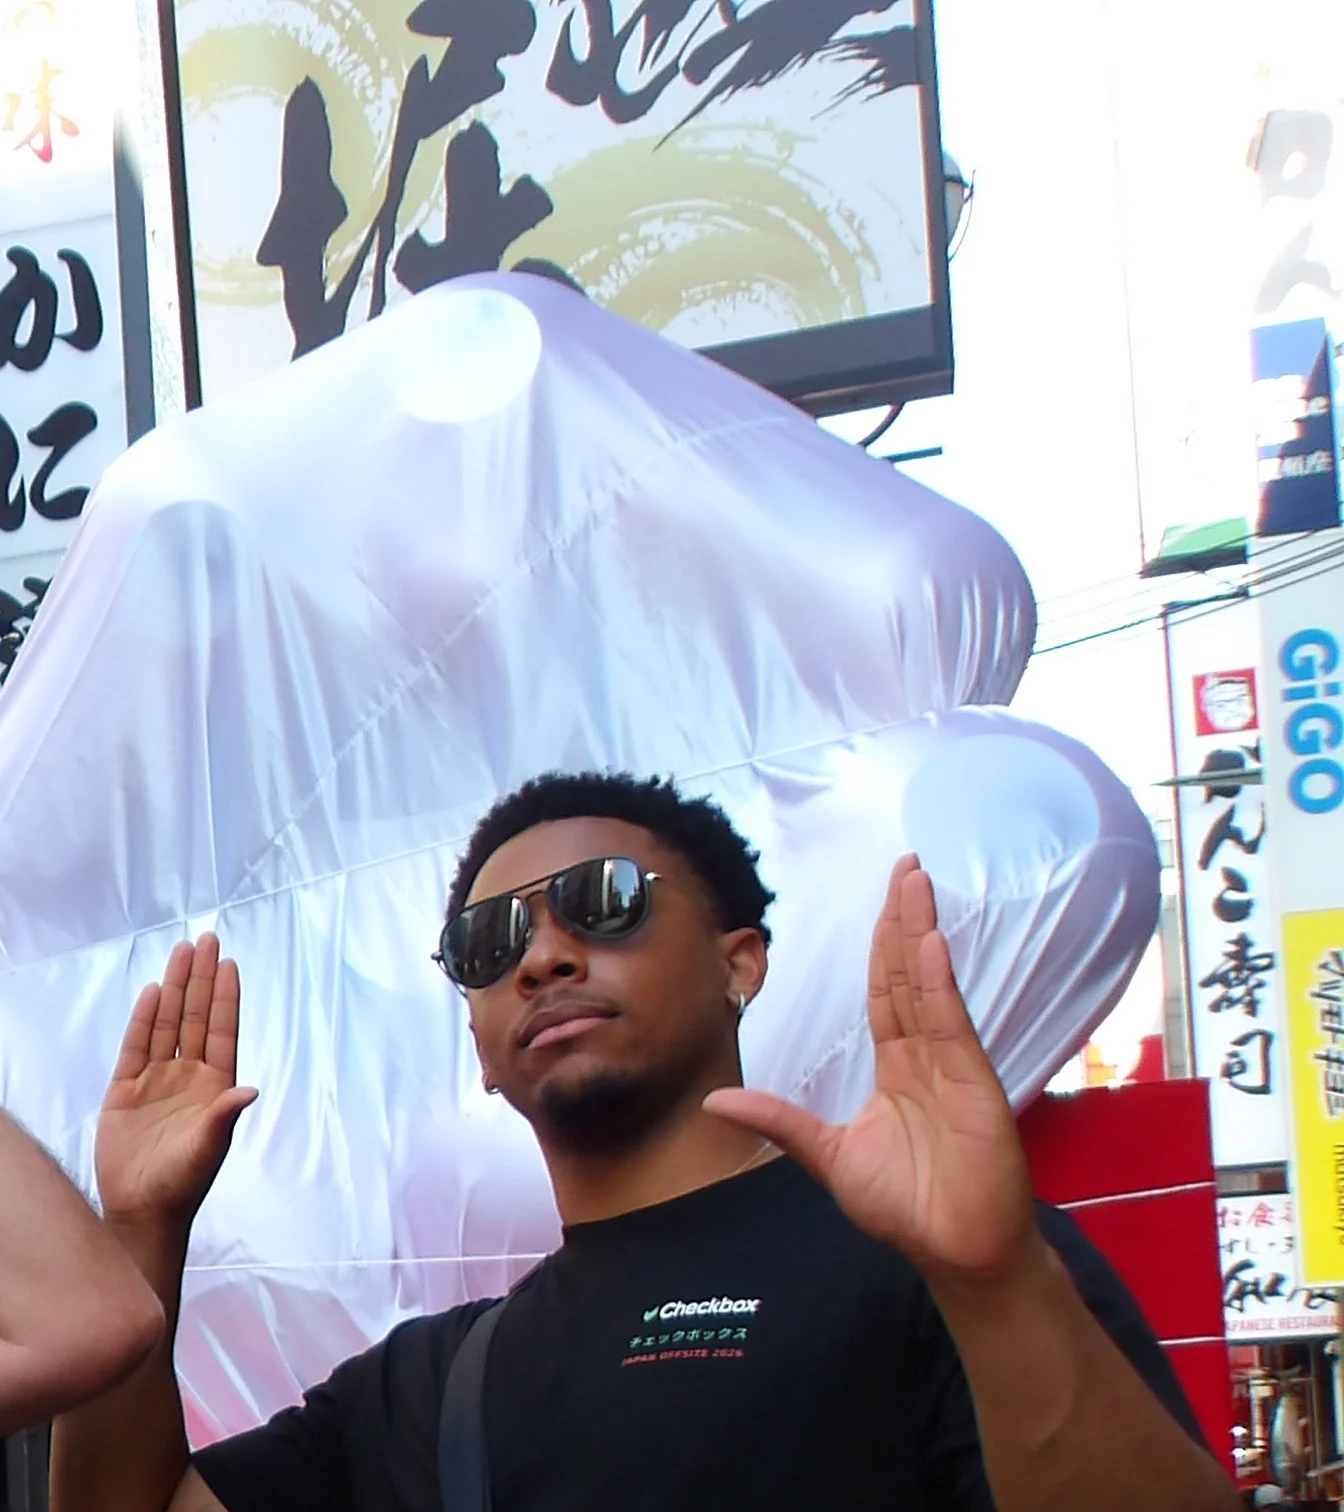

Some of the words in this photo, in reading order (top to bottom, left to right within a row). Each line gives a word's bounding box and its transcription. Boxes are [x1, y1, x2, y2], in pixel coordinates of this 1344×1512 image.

[1278, 628, 1344, 815] GiGO
[659, 1296, 761, 1319] Checkbox
[628, 1327, 748, 1348] チェックボックス
